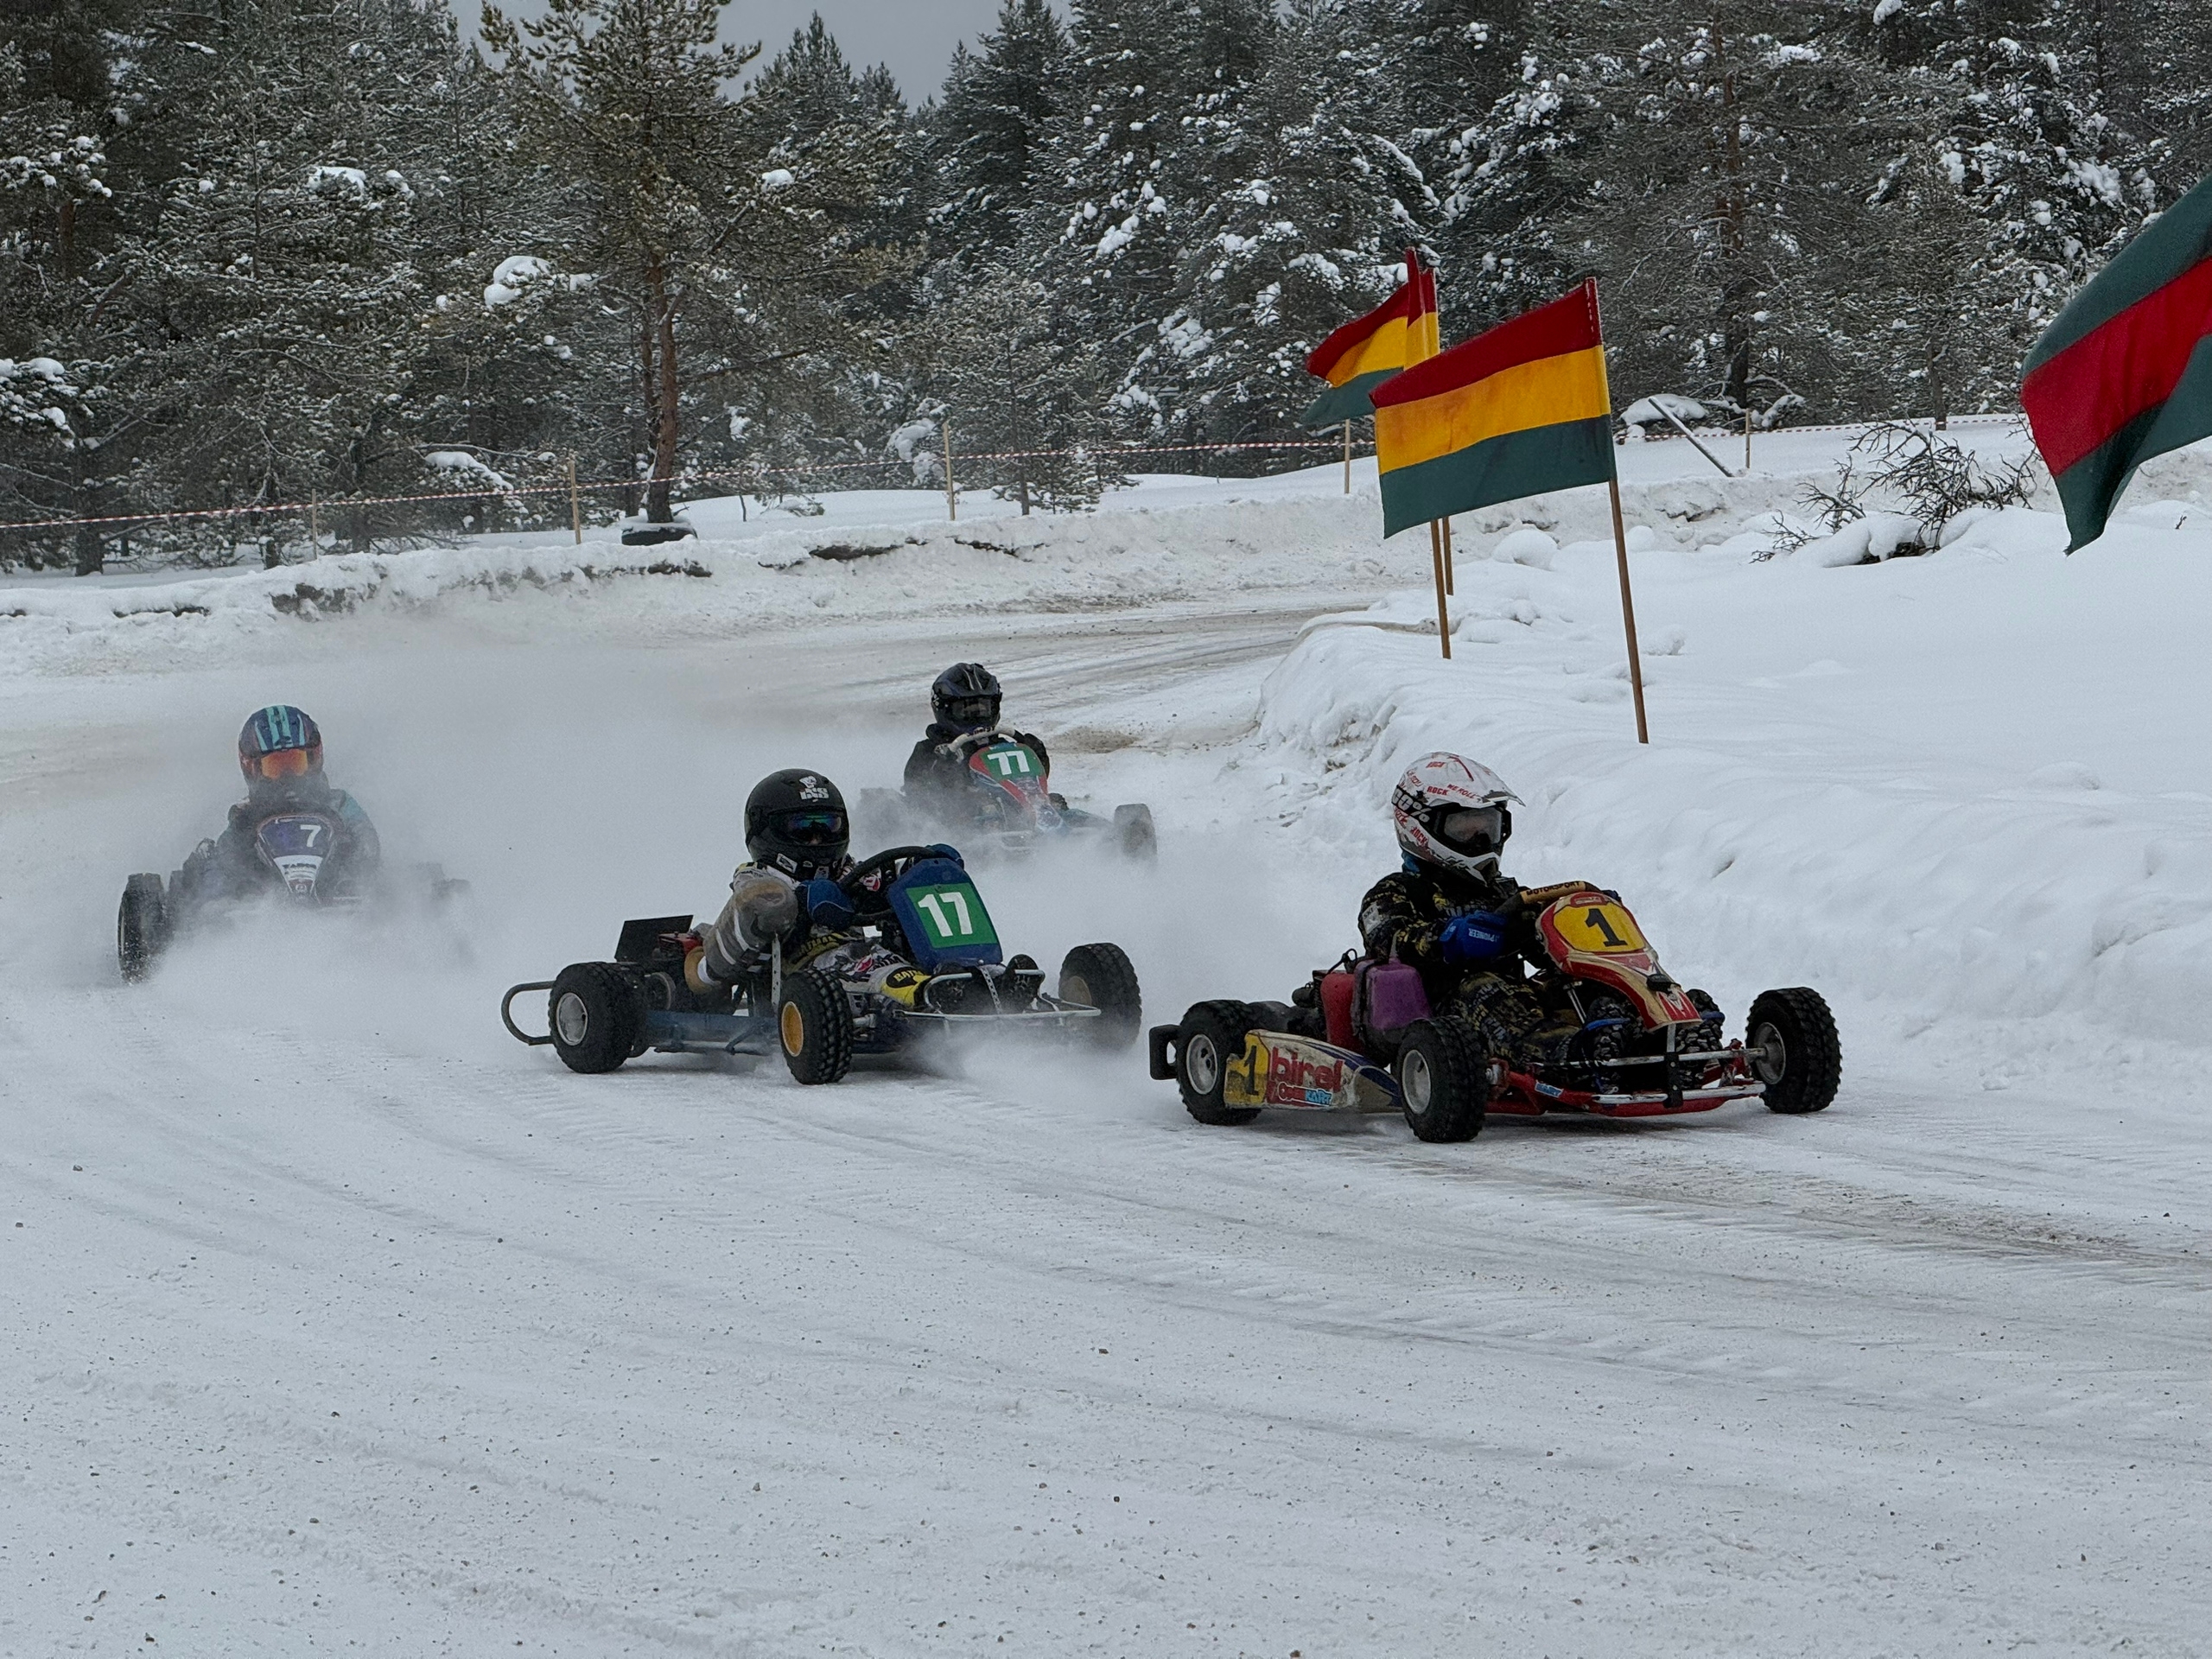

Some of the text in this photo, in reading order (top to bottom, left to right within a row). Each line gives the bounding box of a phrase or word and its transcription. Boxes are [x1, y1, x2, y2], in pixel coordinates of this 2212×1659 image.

[987, 750, 1030, 776] 77
[1427, 785, 1449, 796] ROCK
[300, 823, 321, 848] 7
[1526, 880, 1581, 896] MOTORSPORT
[918, 892, 973, 938] 17
[1584, 907, 1629, 948] 1
[1243, 1045, 1259, 1096] 1
[1270, 1046, 1345, 1093] birel
